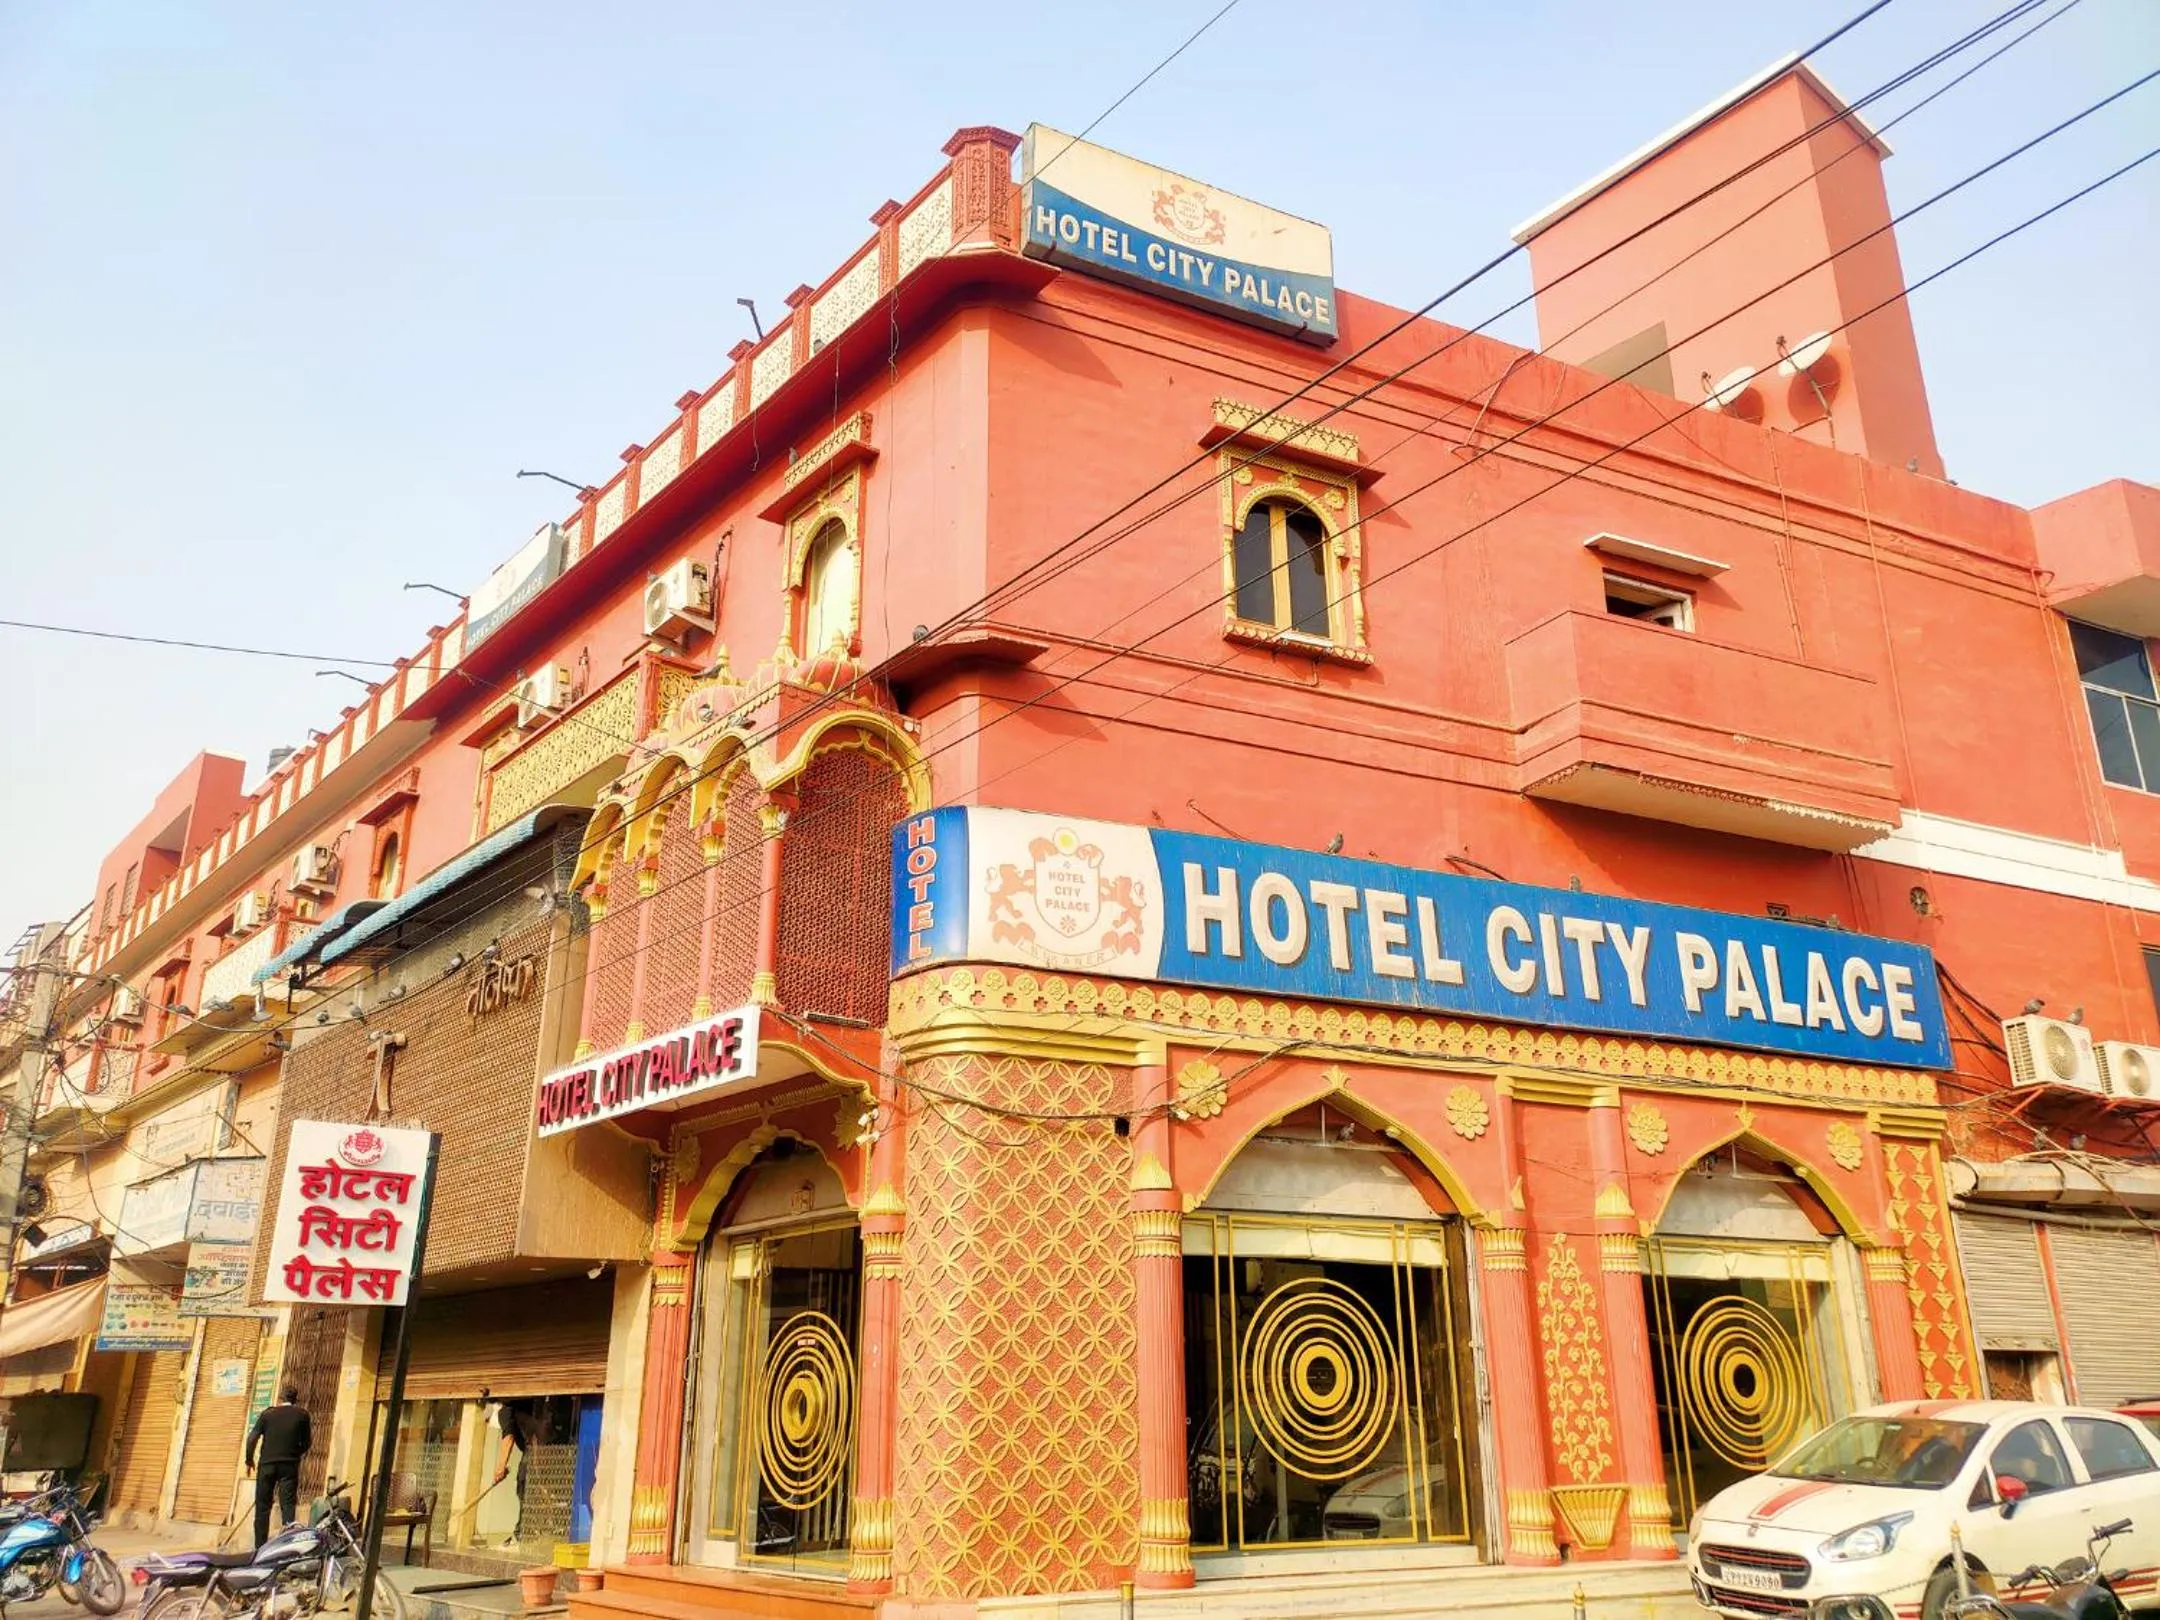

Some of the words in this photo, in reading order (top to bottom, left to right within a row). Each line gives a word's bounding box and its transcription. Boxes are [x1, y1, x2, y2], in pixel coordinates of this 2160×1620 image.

[1036, 204, 1137, 264] HOTEL
[1146, 242, 1214, 287] CITY
[1224, 267, 1331, 325] PALACE
[906, 814, 937, 961] HOTEL
[1048, 871, 1086, 885] HOTEL
[1055, 885, 1081, 897] CITY
[1045, 898, 1090, 913] PALACE
[1183, 861, 1465, 986] HOTEL
[1486, 904, 1650, 1006] CITY
[1675, 930, 1924, 1042] PALACE
[538, 1068, 598, 1127] HOTEL
[600, 1049, 649, 1109] CITY
[649, 1017, 743, 1094] PALACE
[298, 1157, 416, 1205] होटल
[298, 1204, 403, 1252] सिटी
[282, 1254, 402, 1301] पैलेस
